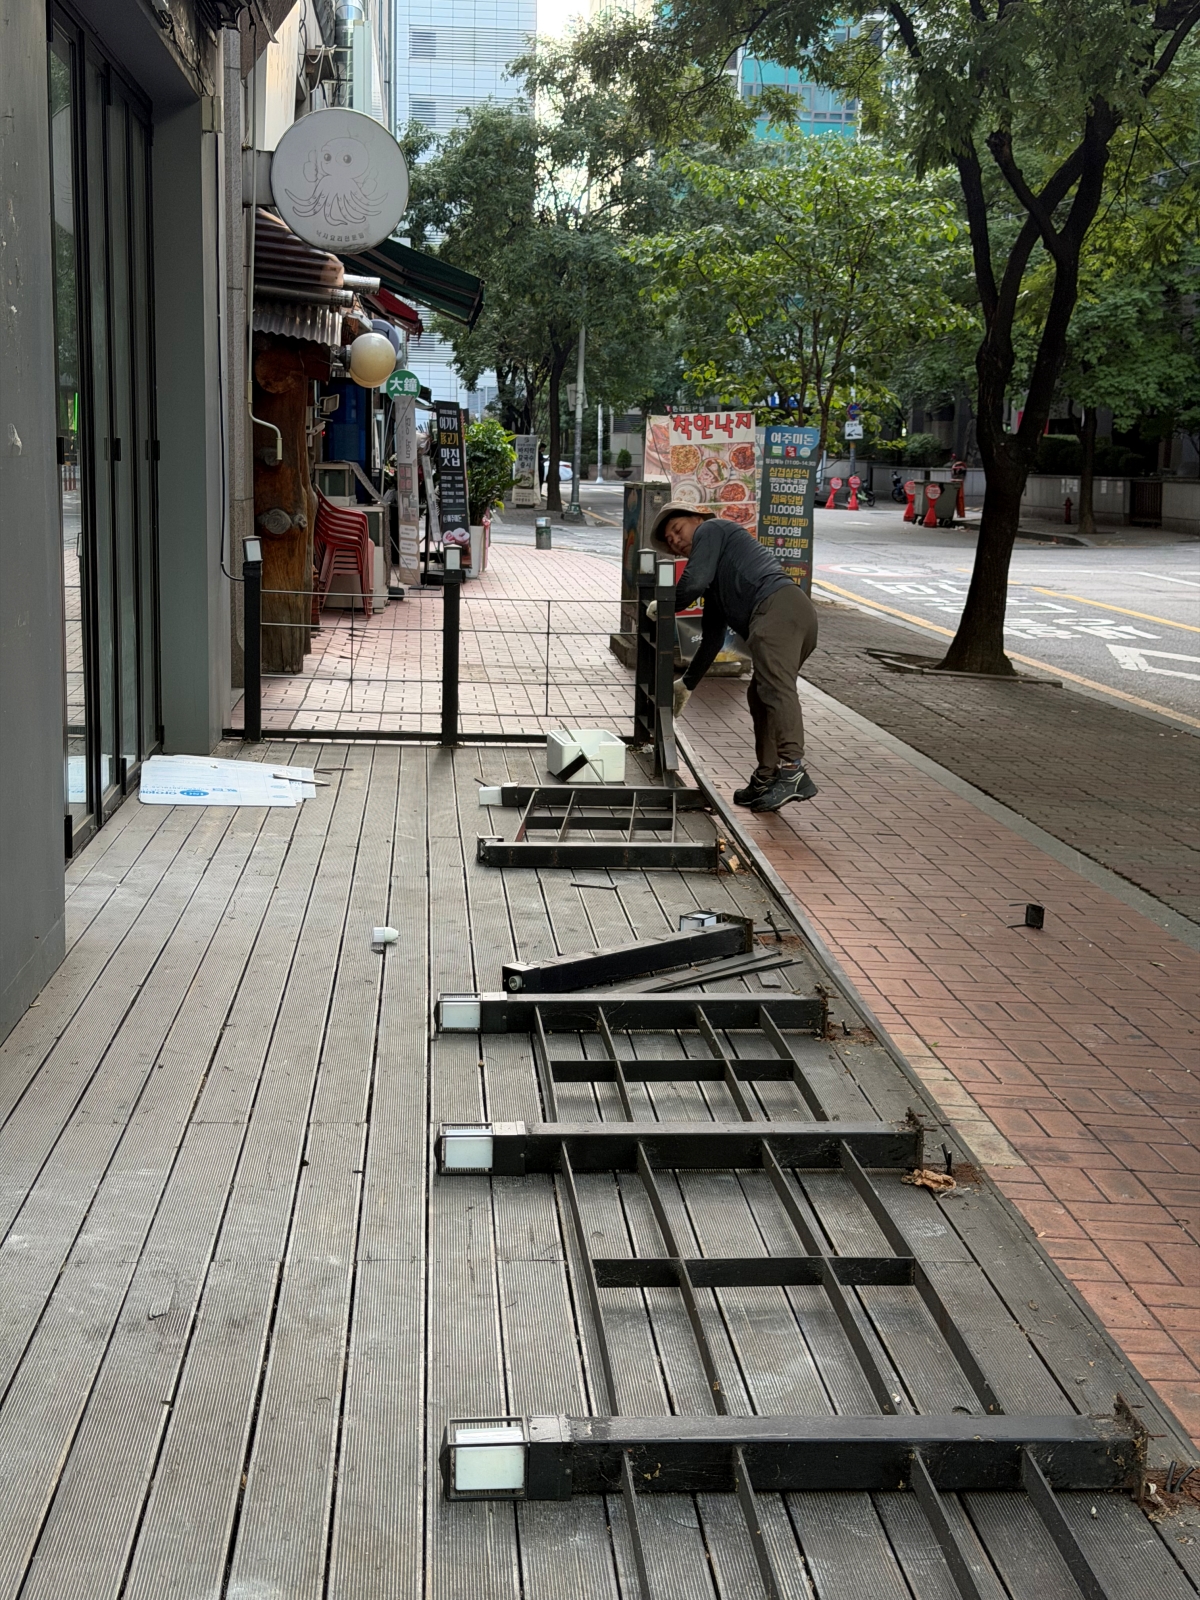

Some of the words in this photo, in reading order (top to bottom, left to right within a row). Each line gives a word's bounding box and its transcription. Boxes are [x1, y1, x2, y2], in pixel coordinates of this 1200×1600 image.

[389, 377, 418, 393] 大鐘
[439, 416, 458, 431] 여기가
[673, 413, 752, 440] 착한낙지
[770, 432, 815, 446] 여주미돈
[440, 447, 461, 467] 맛집
[769, 467, 810, 479] 삼겹살정식
[770, 483, 807, 494] 13,000원
[771, 494, 804, 505] 제육덮밥
[769, 504, 804, 516] 11,000원
[768, 526, 802, 537] 8,000원
[784, 537, 809, 549] 갈비찜
[781, 566, 807, 577] 선메뉴
